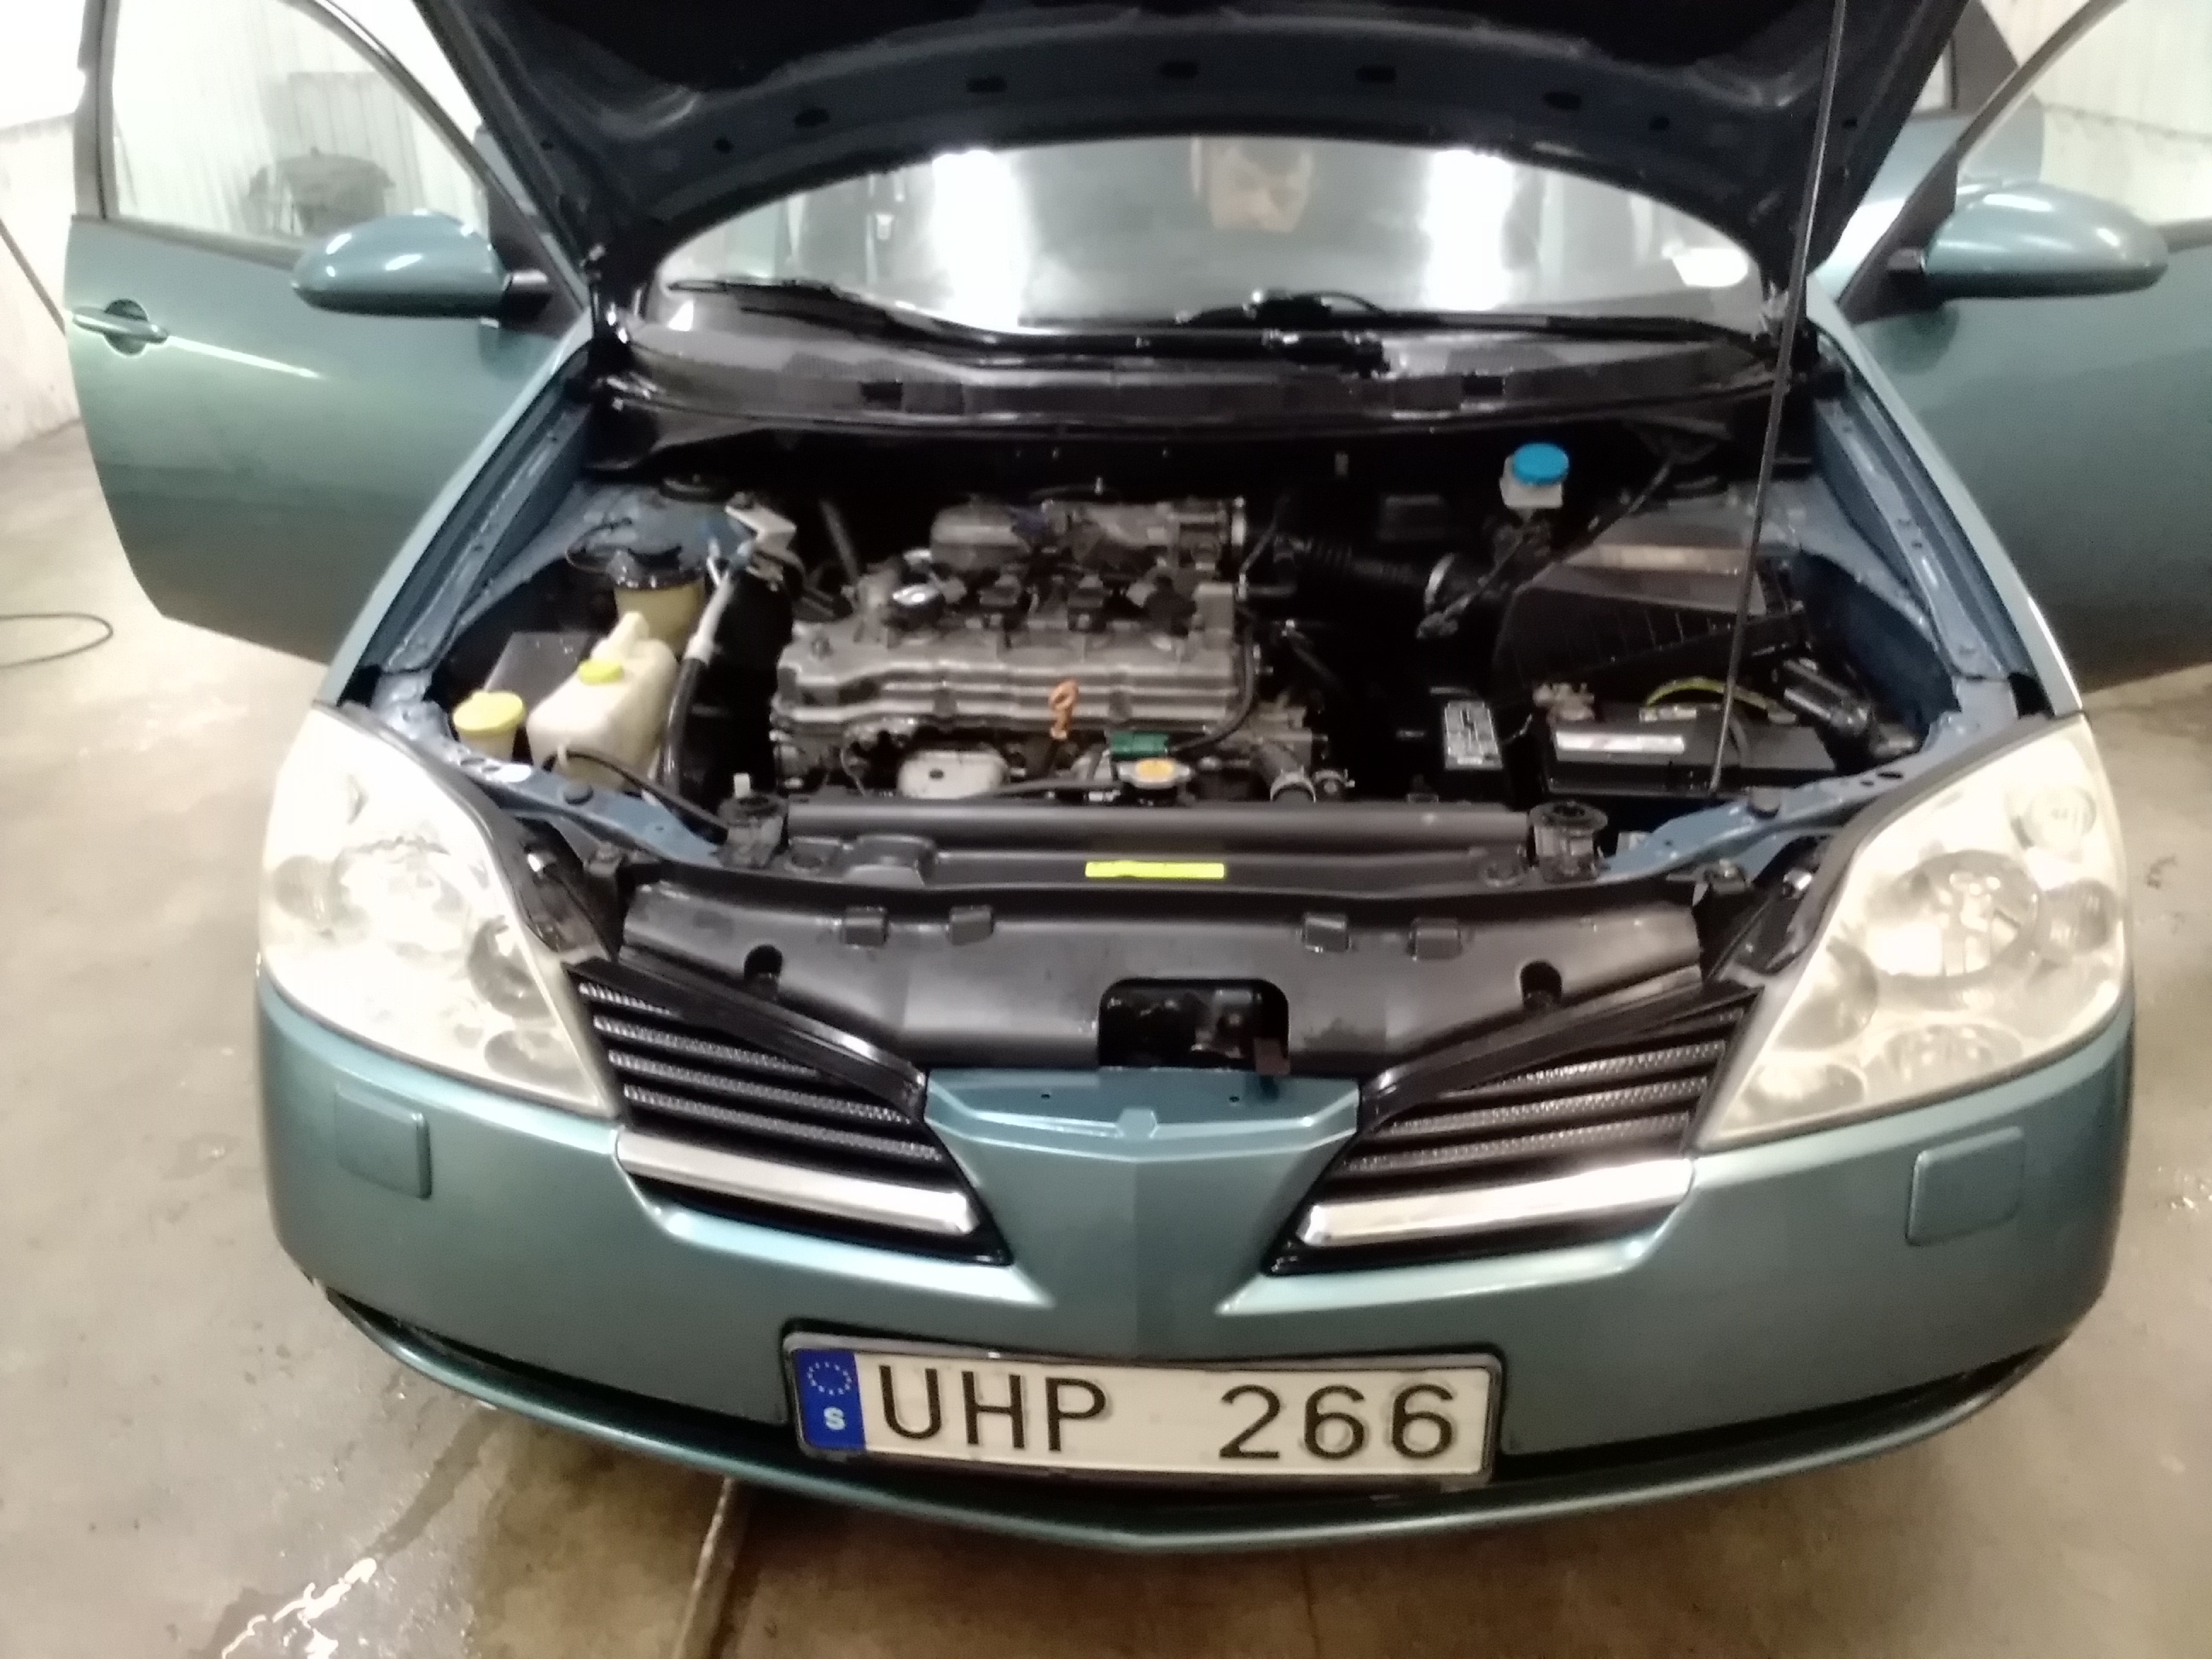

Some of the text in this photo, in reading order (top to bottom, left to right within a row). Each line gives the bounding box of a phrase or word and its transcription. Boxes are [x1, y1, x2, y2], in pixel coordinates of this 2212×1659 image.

[823, 1406, 847, 1431] S
[879, 1365, 1453, 1460] UHP 266
